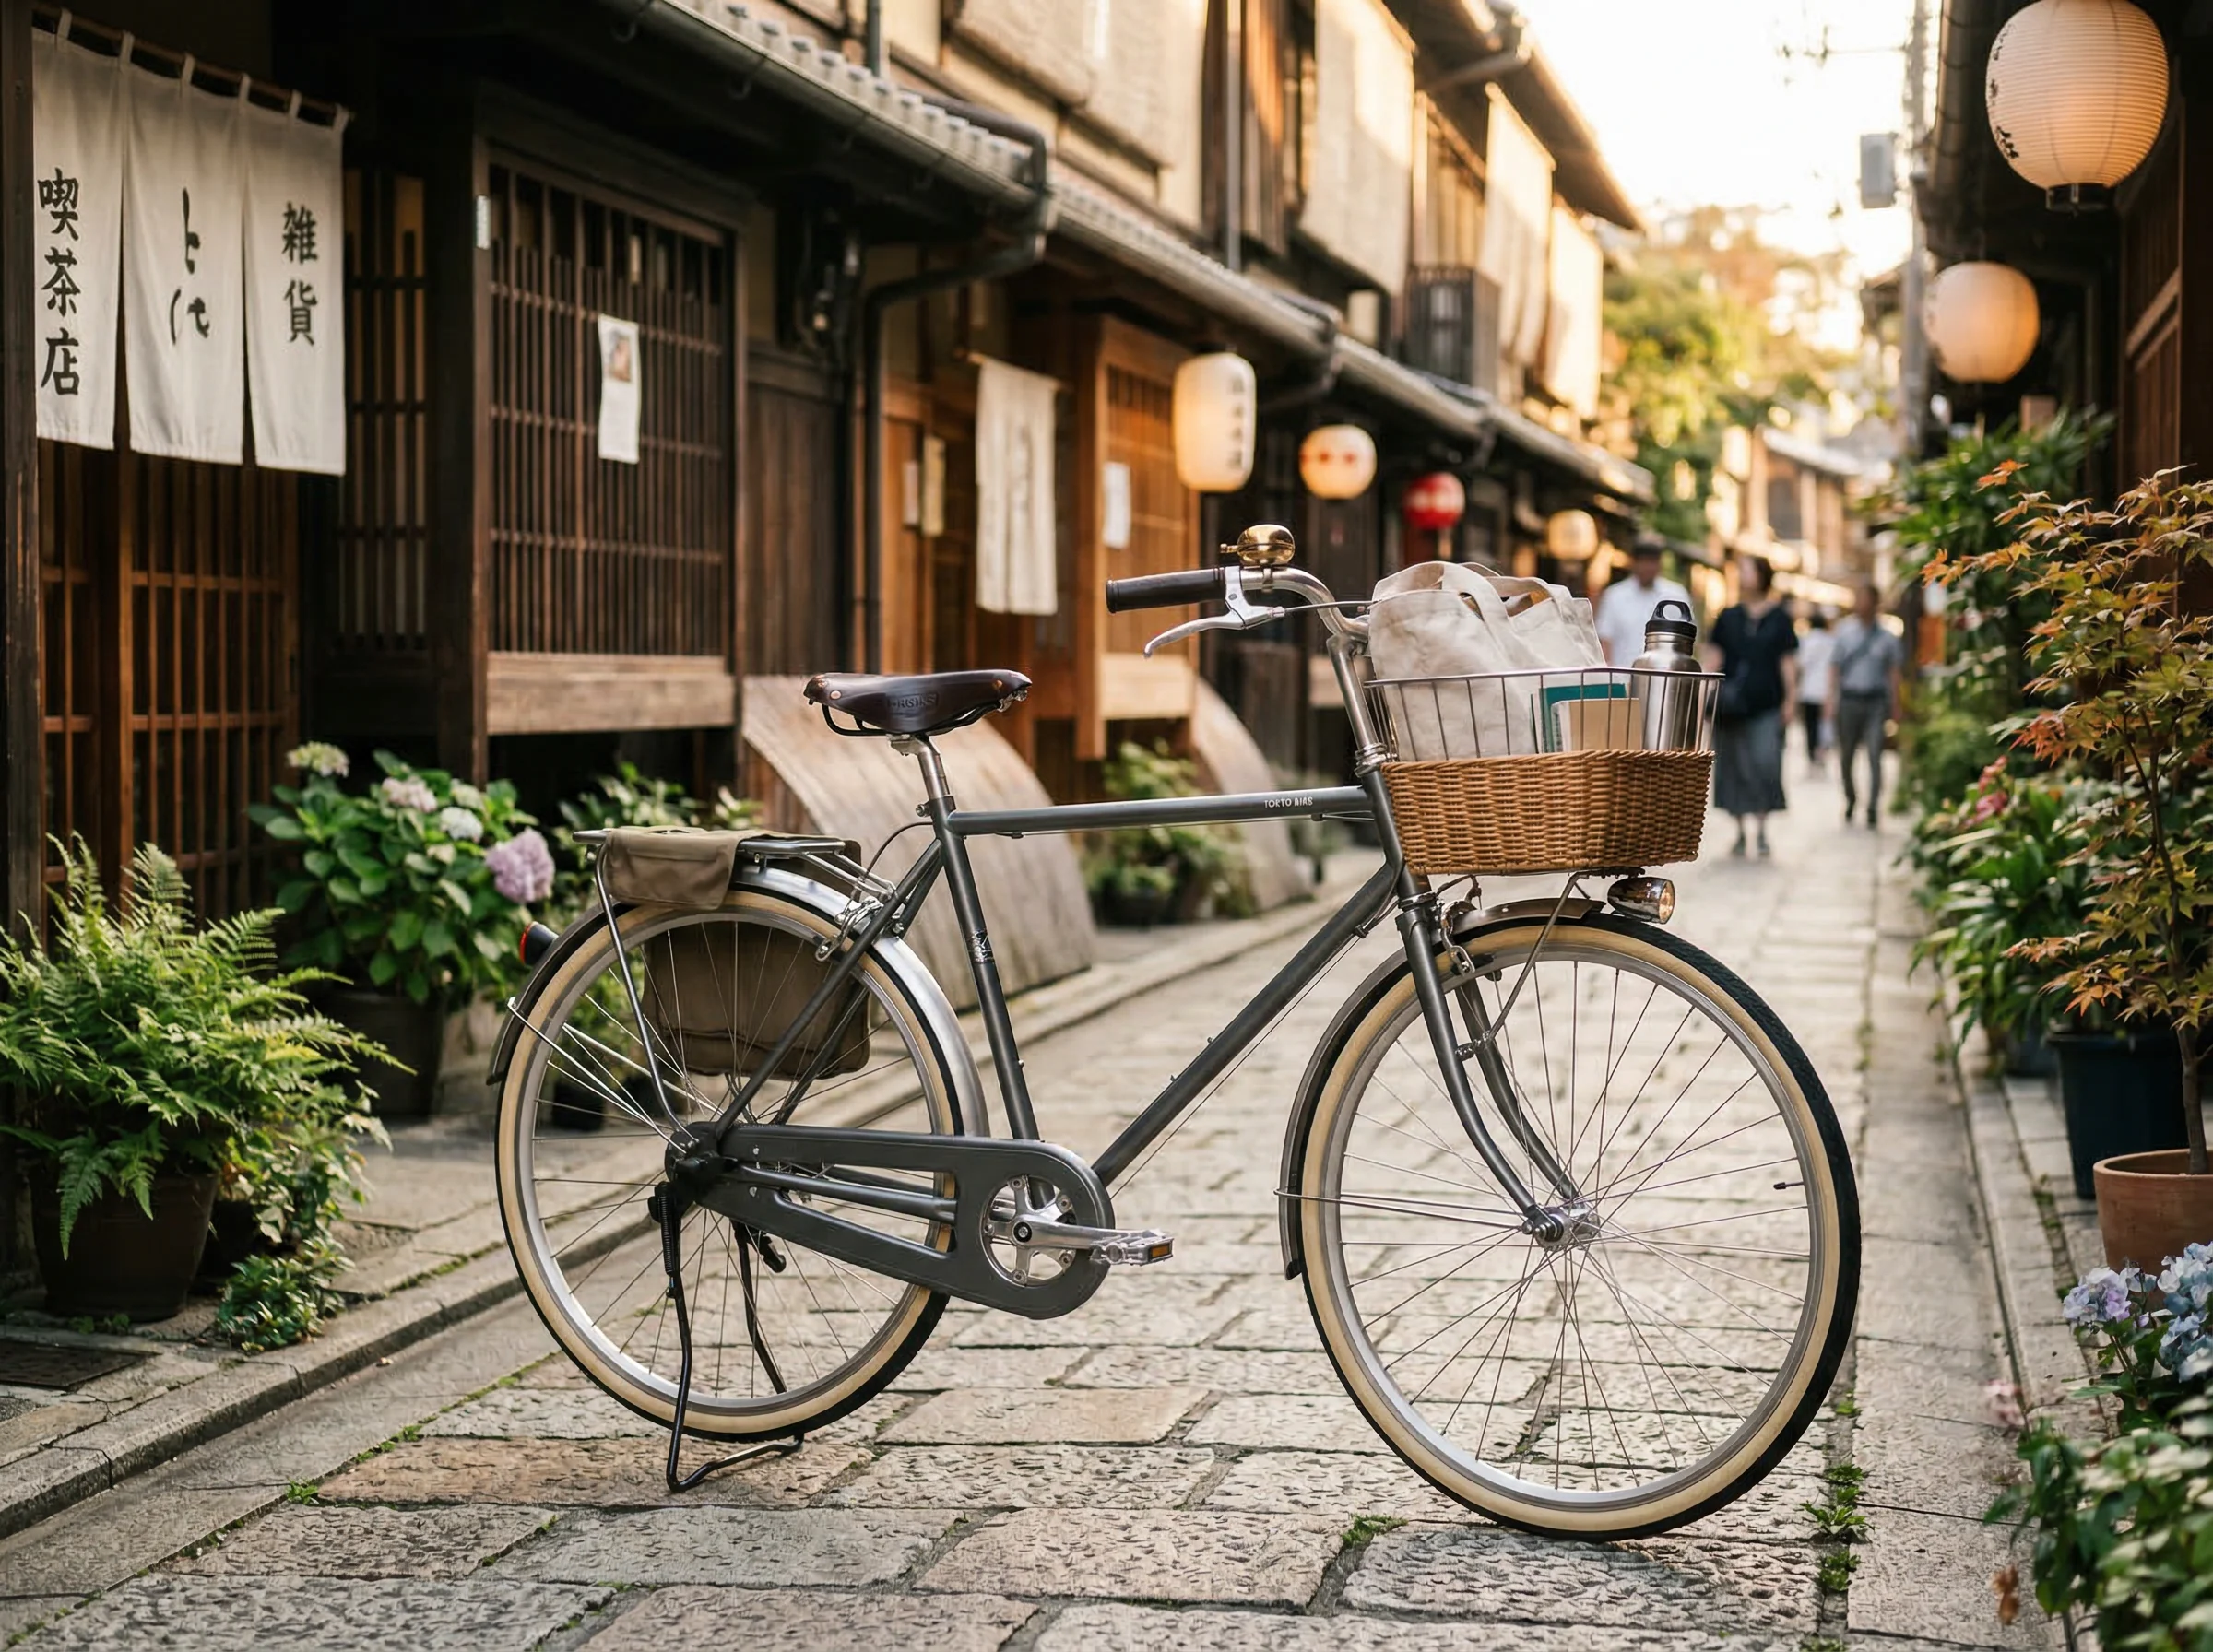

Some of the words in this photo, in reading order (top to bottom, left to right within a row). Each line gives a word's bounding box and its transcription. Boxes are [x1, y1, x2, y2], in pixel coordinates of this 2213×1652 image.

[37, 167, 80, 395] 喫茶店
[282, 201, 318, 347] 雑貨
